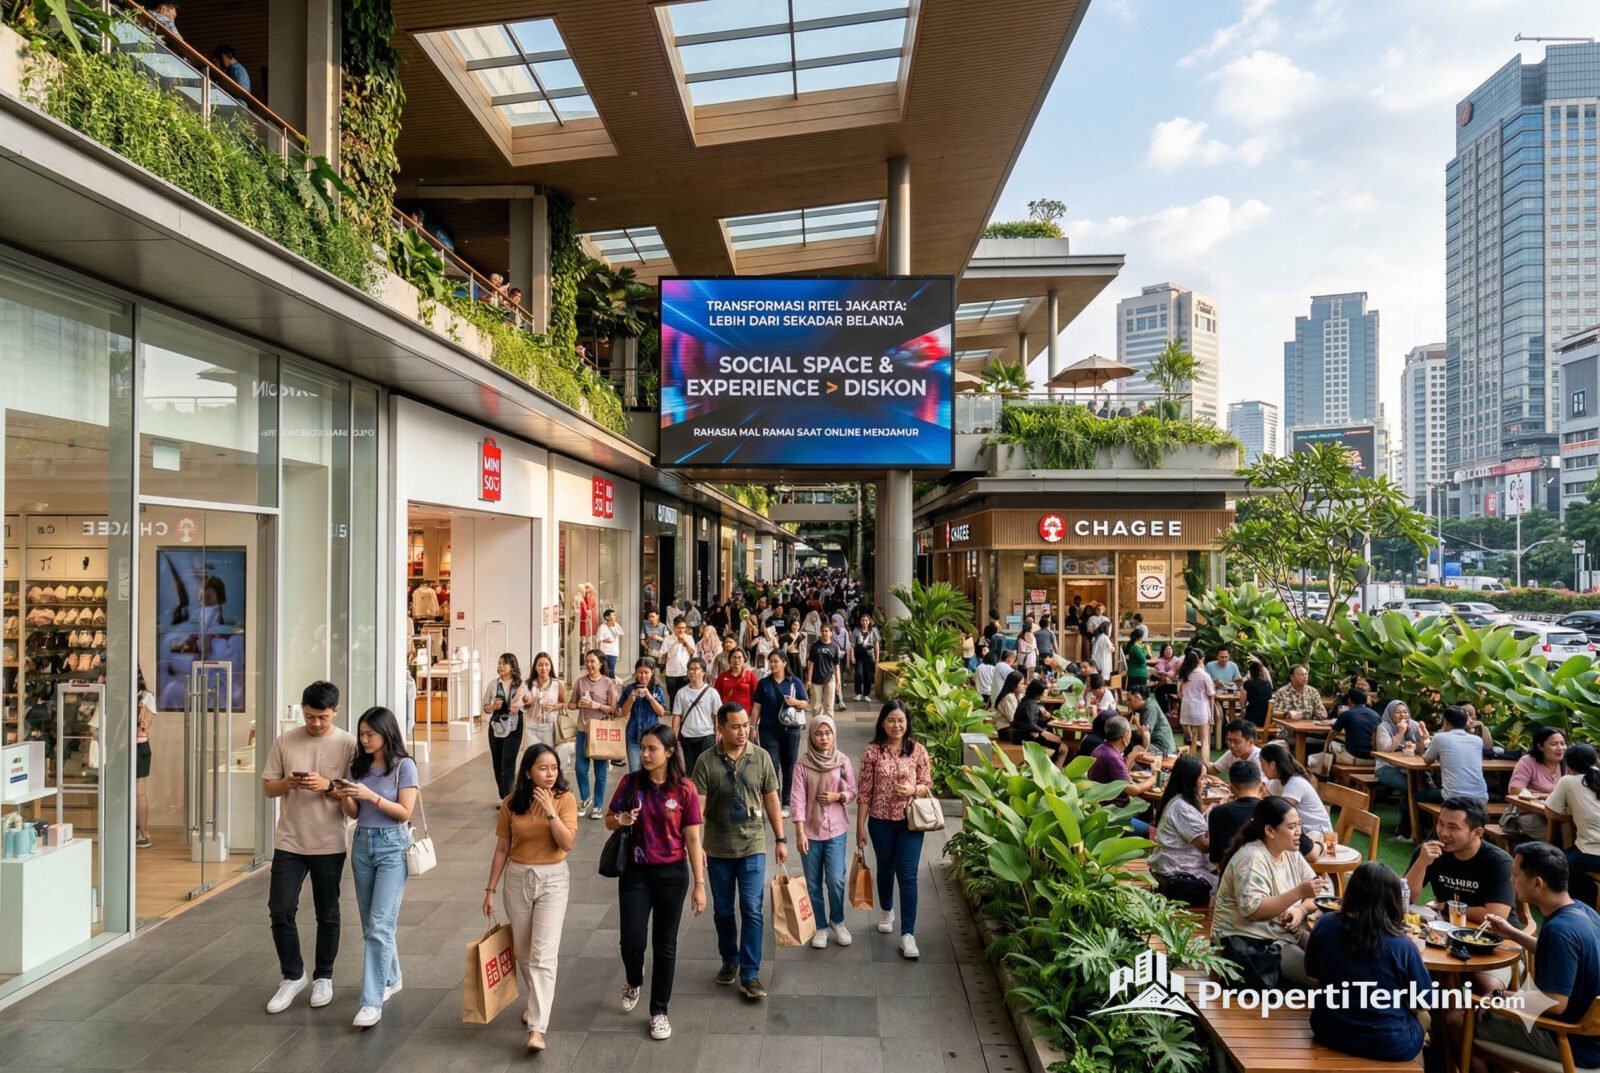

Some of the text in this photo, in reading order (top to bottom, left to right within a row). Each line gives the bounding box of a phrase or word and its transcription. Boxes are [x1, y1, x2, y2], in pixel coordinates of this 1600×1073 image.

[707, 300, 907, 312] TRANSFORMASI RITEL JAKARTA:
[709, 316, 904, 326] LEBIH DARI SEKADAR BELANJA
[719, 356, 894, 374] SOCIAL SPACE &
[687, 379, 819, 396] EXPERIENCE
[845, 379, 927, 396] DISKON
[694, 428, 919, 437] RAHASIA MAL RAMAI SAAT ONLINE MENJAMUR
[484, 456, 500, 473] MINI
[1074, 520, 1182, 536] CHAGEE
